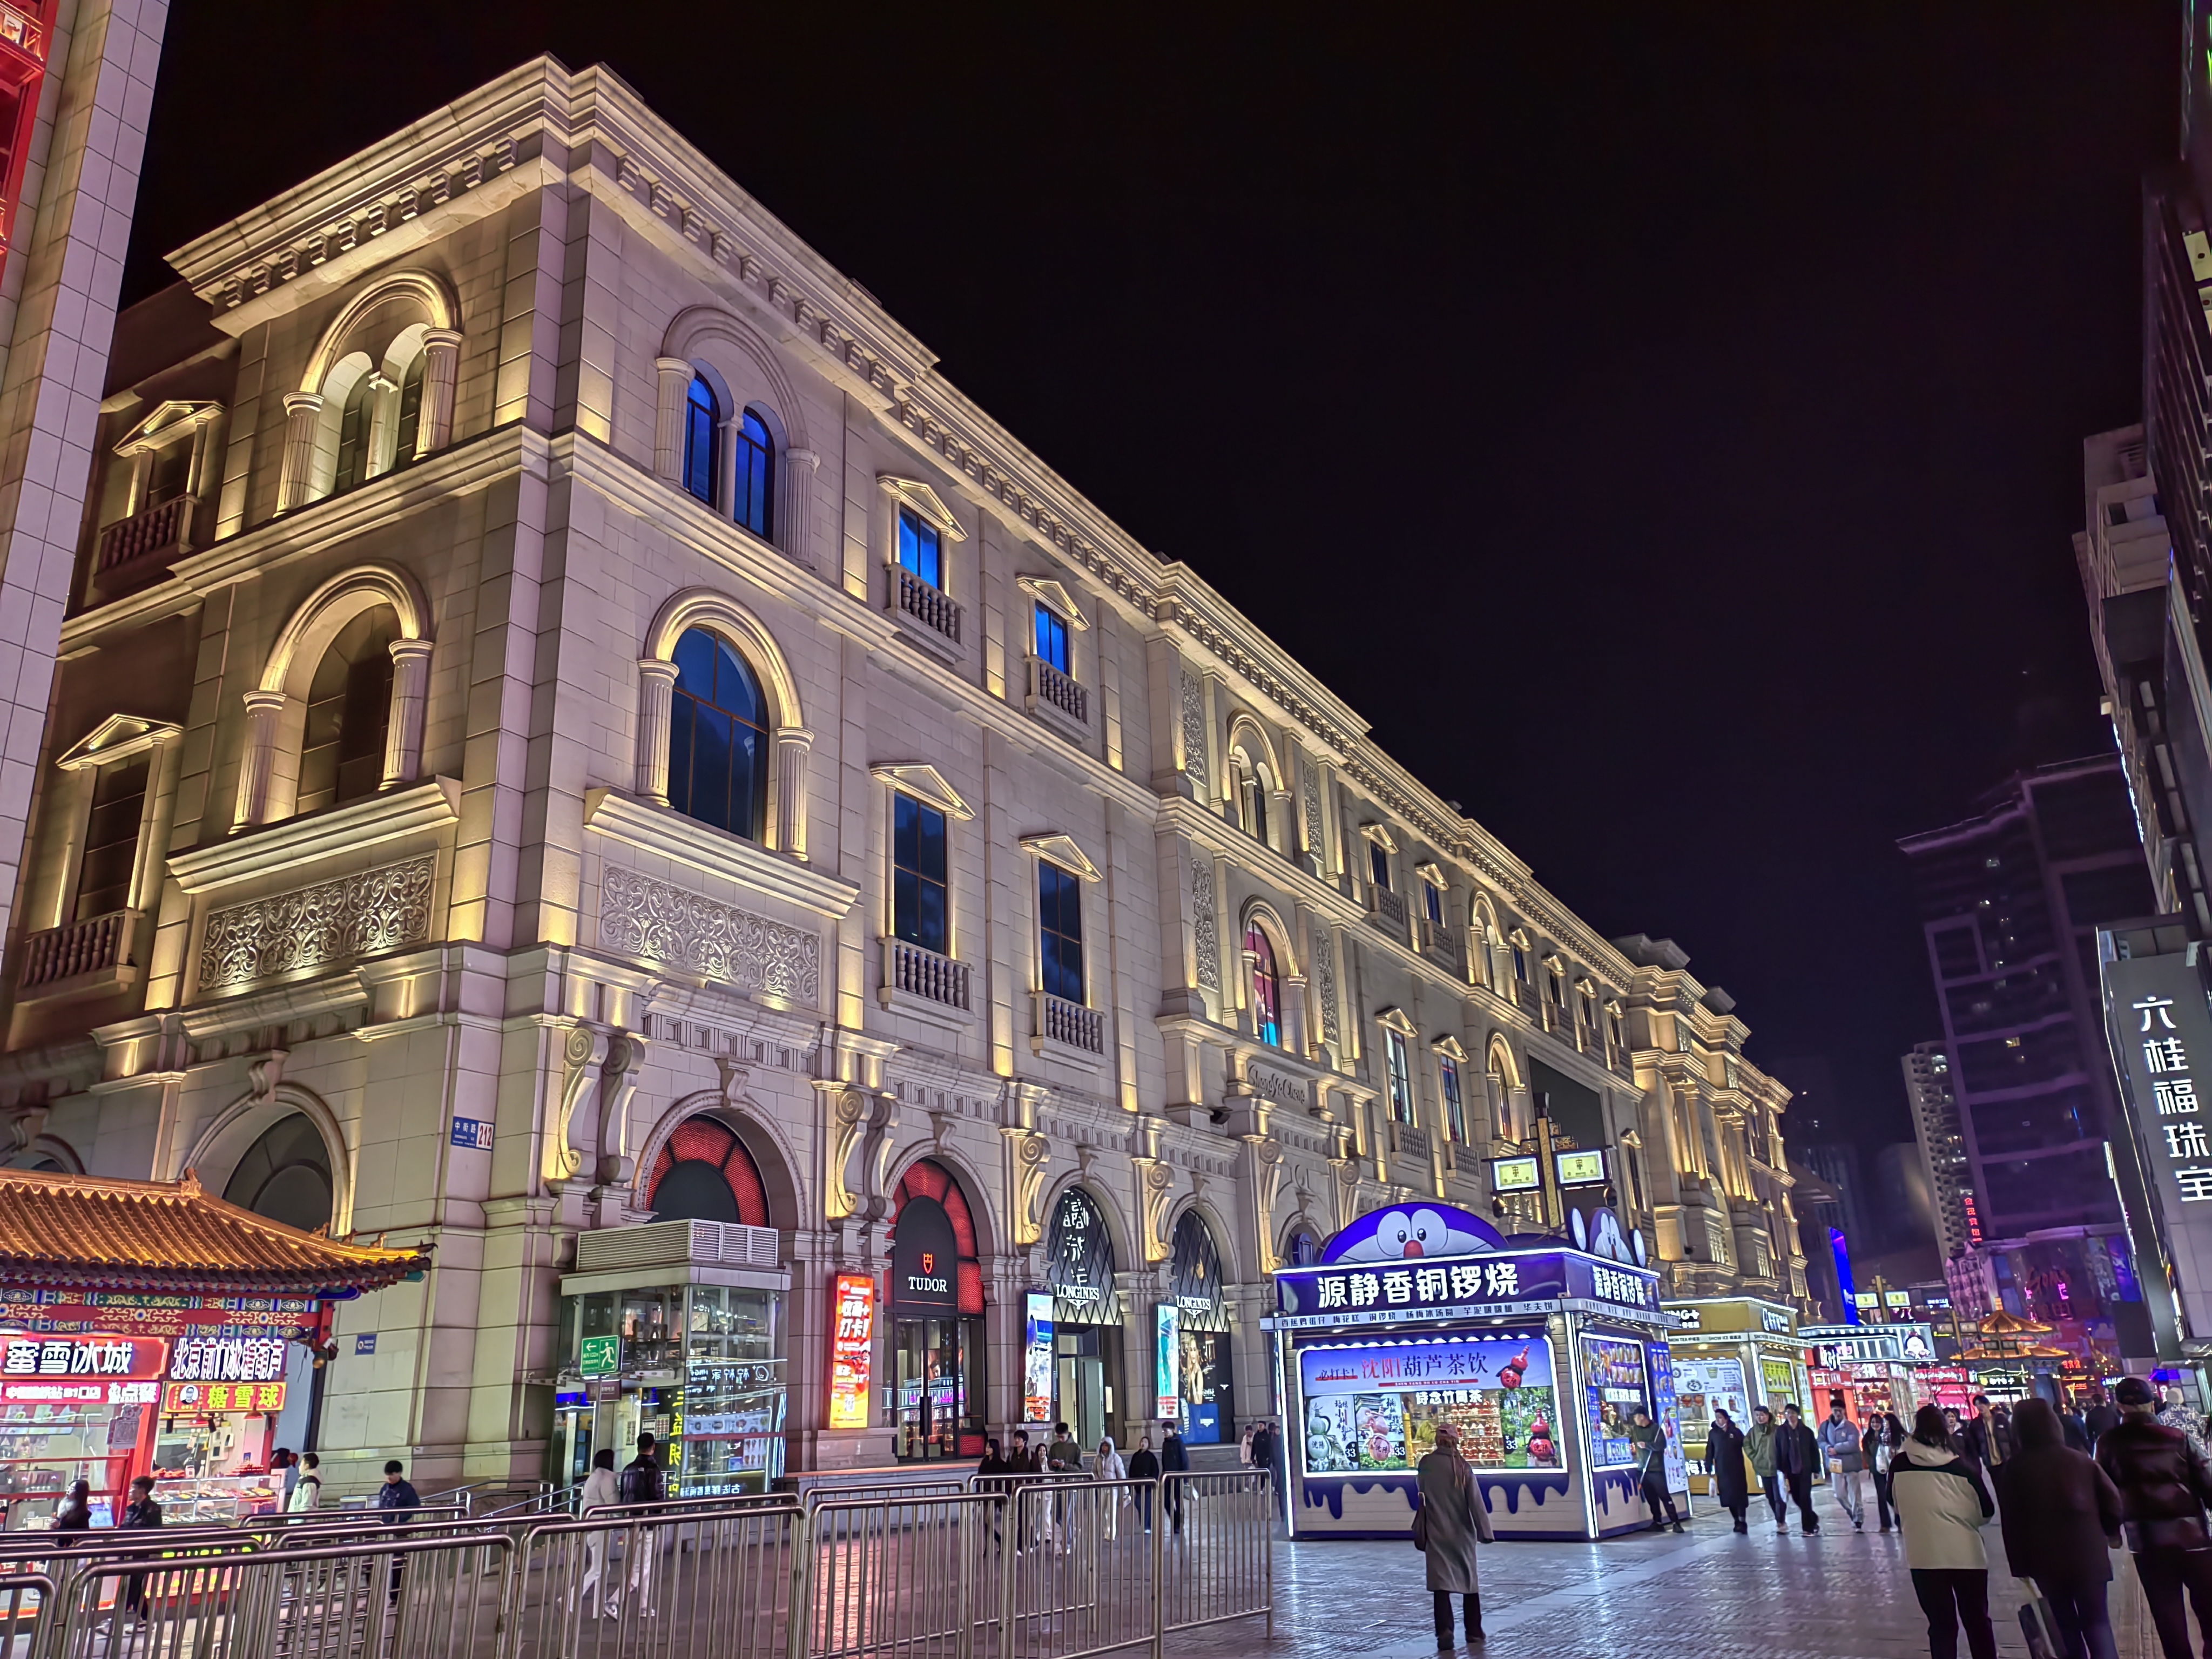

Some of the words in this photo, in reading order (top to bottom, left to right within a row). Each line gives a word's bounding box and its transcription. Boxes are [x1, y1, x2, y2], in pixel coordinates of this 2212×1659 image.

[2133, 996, 2212, 1203] 六桂福珠宝
[478, 1125, 493, 1147] 212
[1964, 1197, 1982, 1242] 金茂宾馆
[908, 1277, 947, 1292] TUDOR
[1056, 1284, 1100, 1300] LONGINES
[1318, 1263, 1520, 1308] 源静香铜锣烧
[1176, 1295, 1211, 1311] LONGINES
[3, 1340, 133, 1374] 蜜雪冰城
[171, 1337, 285, 1380] 北京前门冰糖葫芦
[1361, 1352, 1489, 1379] 沈阳葫芦茶饮
[207, 1385, 280, 1409] 糖雪球
